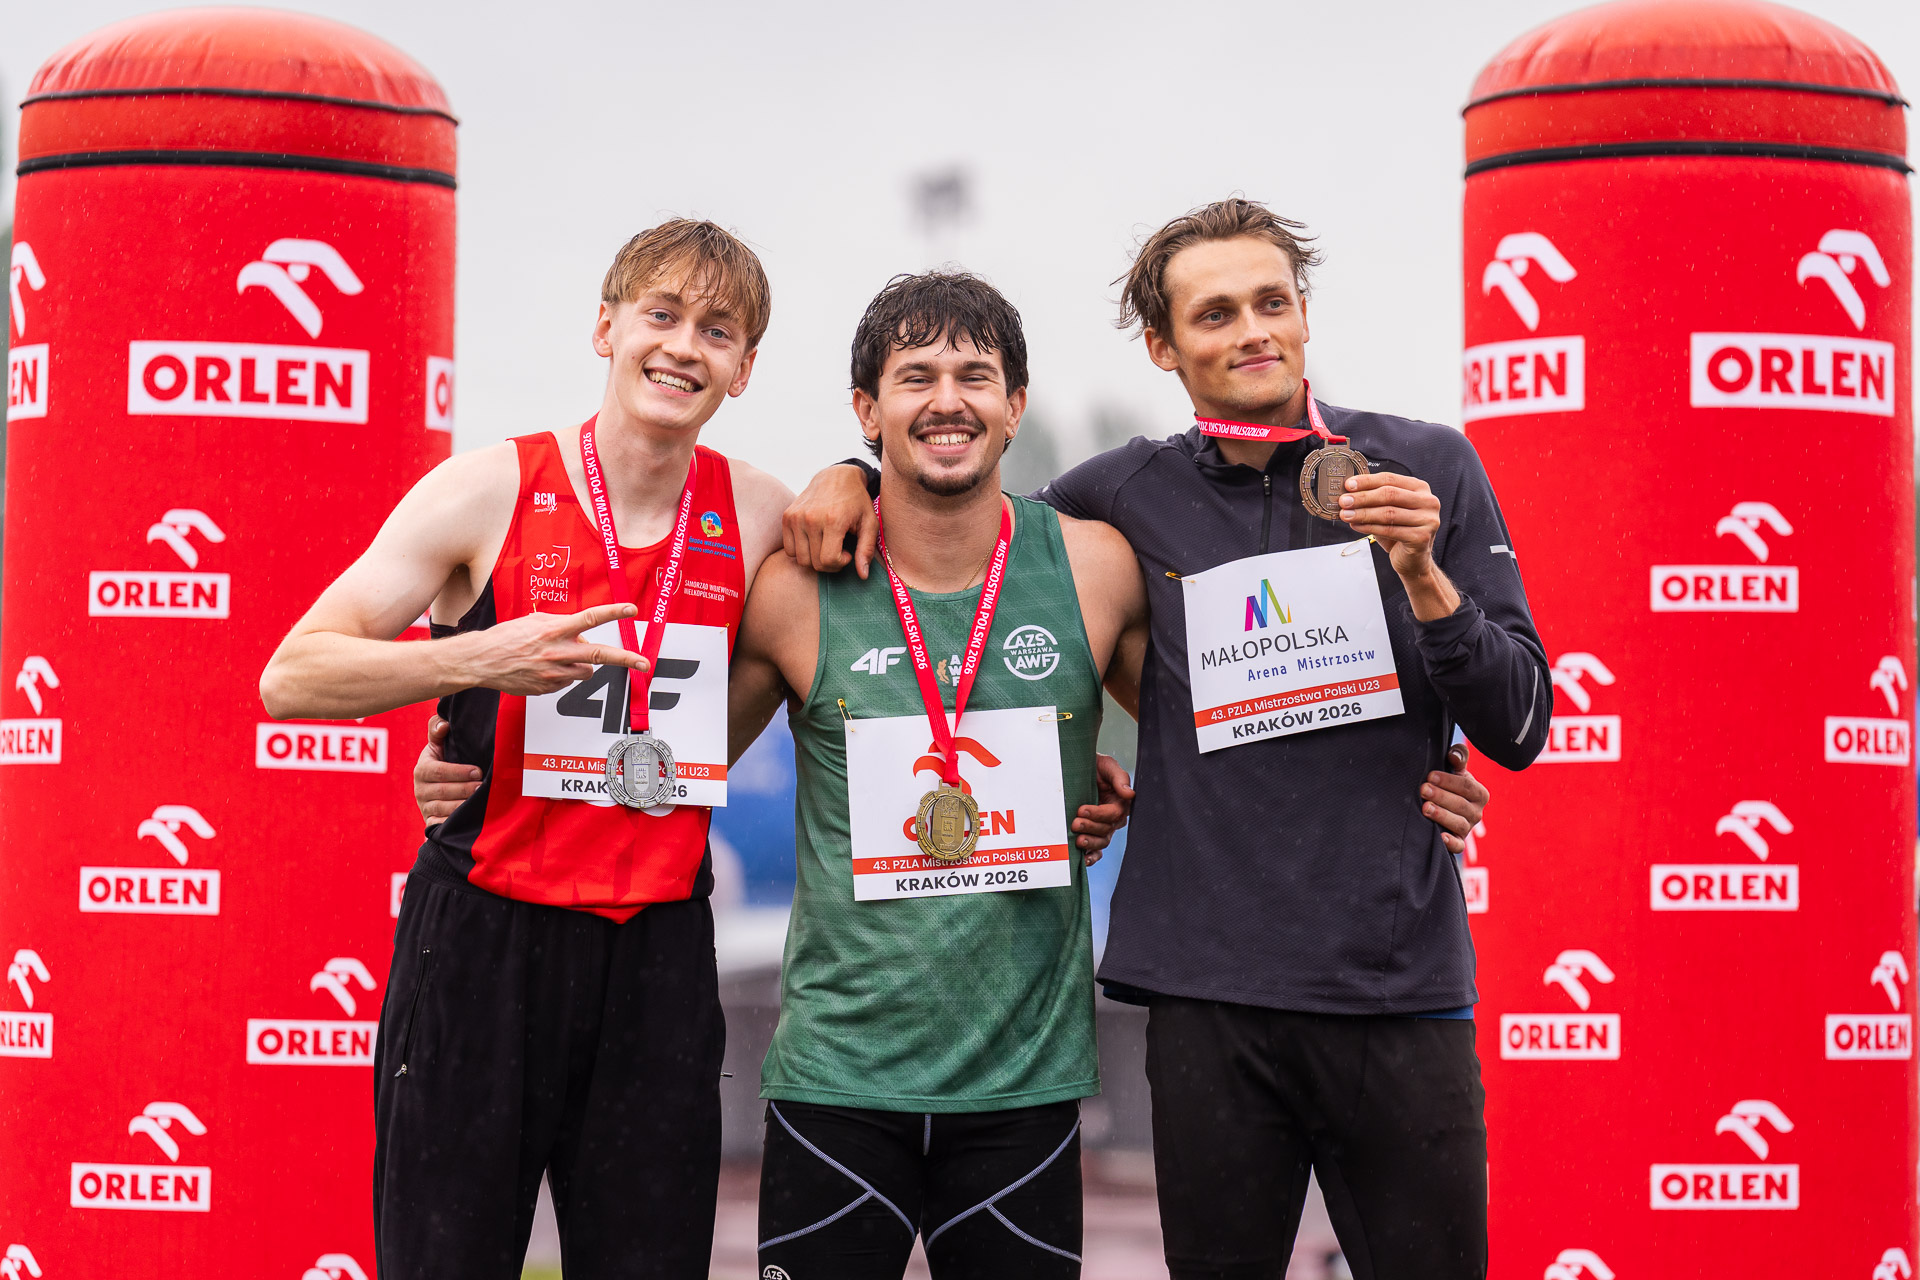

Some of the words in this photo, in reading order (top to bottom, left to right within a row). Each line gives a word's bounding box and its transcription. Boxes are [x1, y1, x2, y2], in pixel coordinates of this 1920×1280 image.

[143, 354, 353, 408] ORLEN
[1464, 352, 1566, 406] RLEN
[1707, 346, 1885, 401] ORLEN
[1197, 419, 1208, 432] 202
[1208, 422, 1230, 435] POLSKI
[1229, 425, 1271, 438] MISTRZOSTWA
[584, 432, 593, 454] 2026
[587, 458, 602, 494] POLSKI
[534, 492, 555, 505] BCM
[596, 497, 619, 569] MISTRZOSTWA
[670, 489, 692, 558] MISTRZOSTWA
[530, 575, 569, 590] Powiat
[659, 559, 679, 597] POLSKI
[981, 539, 1007, 609] MISTRZOSTWA
[97, 580, 218, 610] ORLEN
[530, 586, 569, 602] Średzki
[1661, 576, 1788, 602] ORLEN
[653, 598, 668, 624] 2026
[901, 606, 920, 642] POLSKI
[912, 643, 928, 669] 2026
[971, 611, 989, 647] POLSKI
[1013, 633, 1046, 649] AZS
[850, 647, 907, 674] 4F
[1010, 646, 1053, 655] WARSZAWA
[1201, 625, 1349, 670] MAŁOPOLSKA
[963, 649, 979, 674] 2026
[1015, 654, 1053, 670] AWF
[1248, 664, 1287, 682] Arena
[1297, 649, 1375, 671] Mistrzostw
[1211, 709, 1226, 721] 43.
[1227, 704, 1253, 717] PZLA
[1255, 691, 1322, 711] Mistrzostwa
[1324, 684, 1356, 698] Polski
[1358, 680, 1380, 692] U23
[1232, 710, 1313, 738] KRAKÓW
[1318, 702, 1362, 722] 2026
[266, 733, 379, 763] ORLEN
[1549, 725, 1608, 753] LEN
[1834, 727, 1905, 754] ORLEN
[542, 758, 558, 769] 43.
[561, 760, 585, 771] PZLA
[689, 767, 710, 777] U23
[902, 809, 1016, 842] OEN
[873, 861, 890, 871] 43.
[892, 859, 920, 870] PZLA
[922, 854, 990, 869] Mistrzostwa
[993, 850, 1026, 863] Polski
[1028, 849, 1050, 860] U23
[87, 874, 208, 905] ORLEN
[896, 872, 980, 892] KRAKÓW
[985, 870, 1029, 885] 2026
[1662, 874, 1788, 901] ORLEN
[256, 1028, 370, 1057] ORLEN
[1508, 1024, 1608, 1049] ORLEN
[1834, 1024, 1907, 1050] ORLEN
[78, 1172, 199, 1201] ORLEN
[1661, 1173, 1788, 1200] ORLEN
